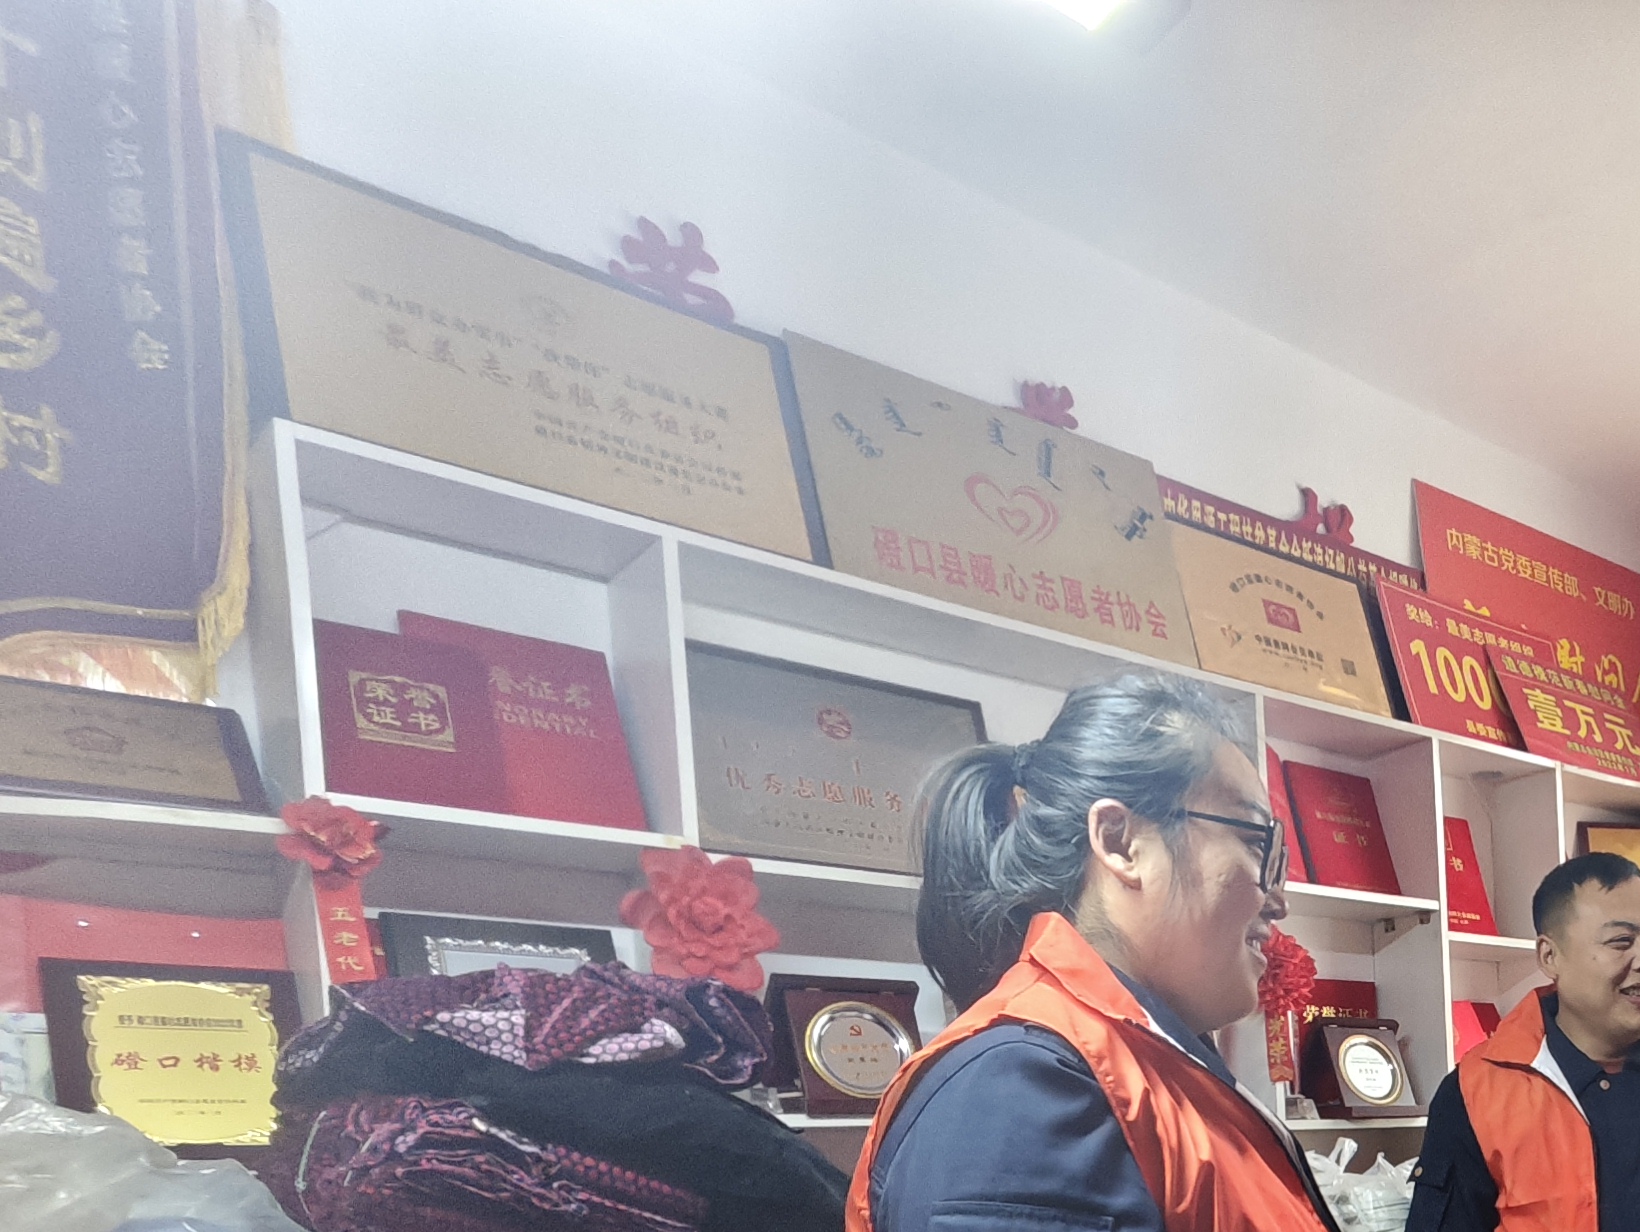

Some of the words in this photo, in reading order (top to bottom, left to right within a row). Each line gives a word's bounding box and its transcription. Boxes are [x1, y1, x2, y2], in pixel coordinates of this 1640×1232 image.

[872, 524, 1169, 641] 磴口县暖心志愿者协会
[1445, 527, 1636, 621] 内蒙古党委宣传部、文明办
[365, 680, 438, 709] 荣誉
[366, 703, 442, 732] 证书
[110, 1051, 263, 1074] 磴口楷模
